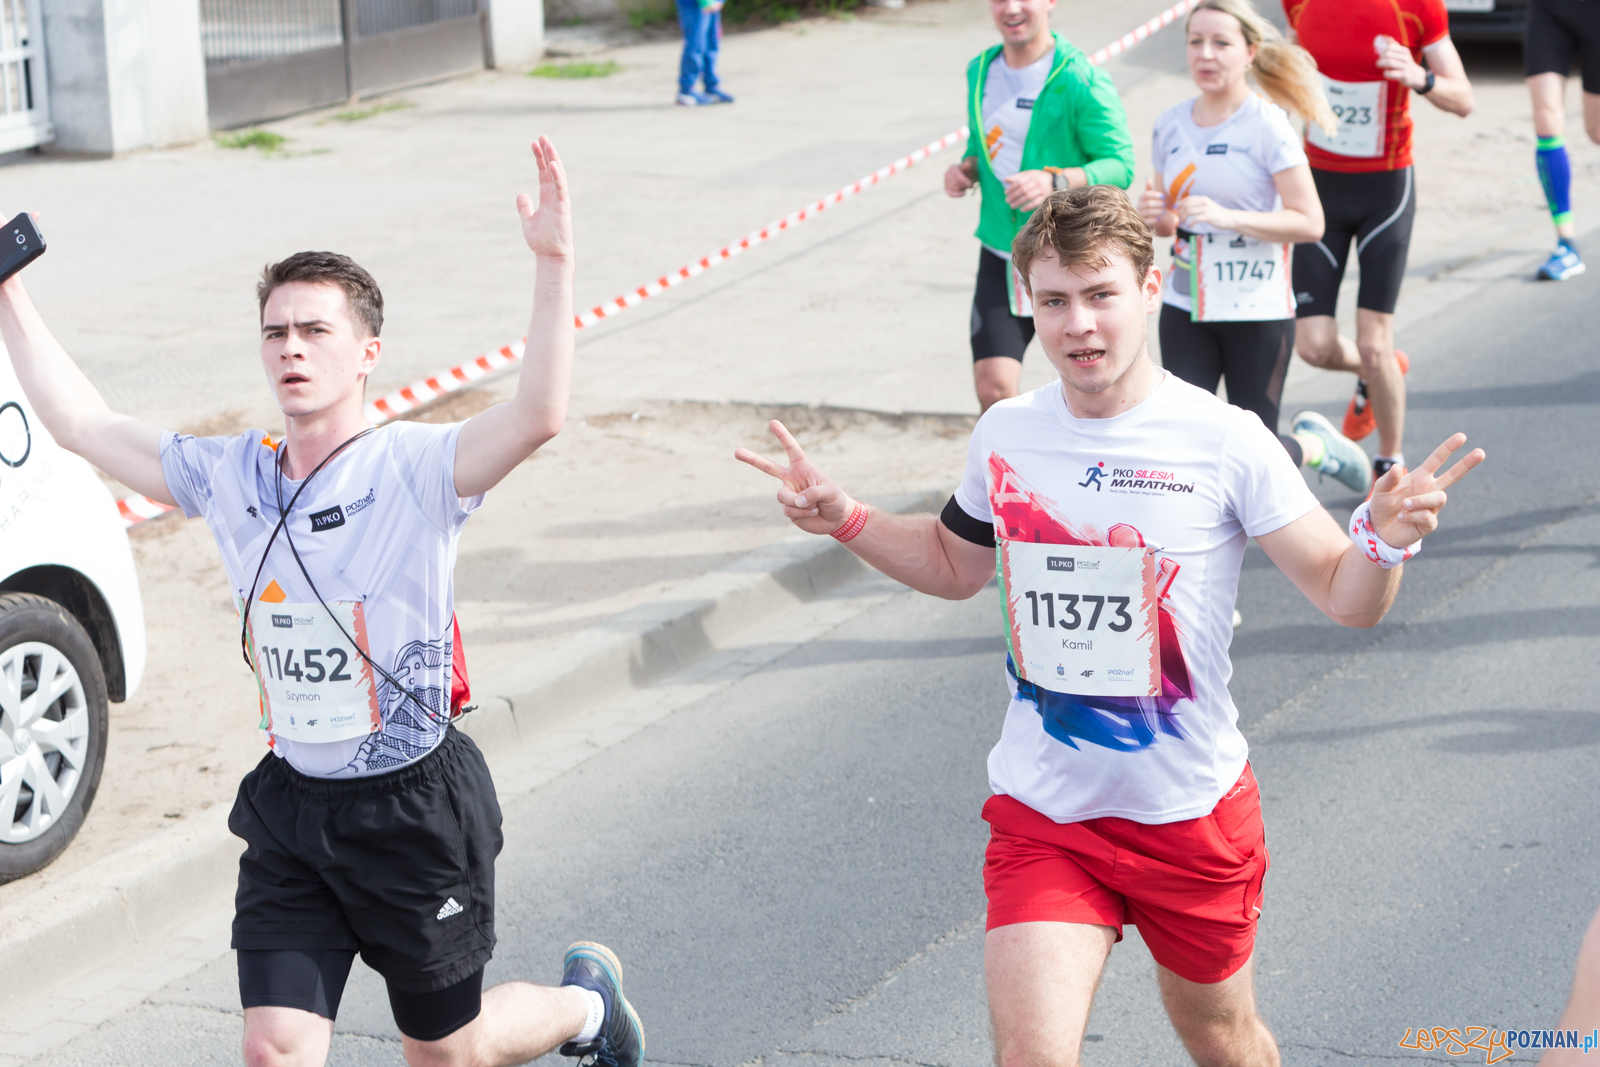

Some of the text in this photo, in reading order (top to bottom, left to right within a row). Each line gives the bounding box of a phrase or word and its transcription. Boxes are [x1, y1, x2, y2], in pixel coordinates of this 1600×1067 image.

[1214, 260, 1276, 281] 11747
[1112, 468, 1174, 481] PKO SILESIA
[1110, 479, 1194, 493] MARATHON
[1025, 590, 1132, 633] 11373
[1062, 638, 1093, 650] Kamil
[261, 645, 352, 683] 11452
[285, 690, 320, 702] Szymon
[436, 905, 463, 920] adidas
